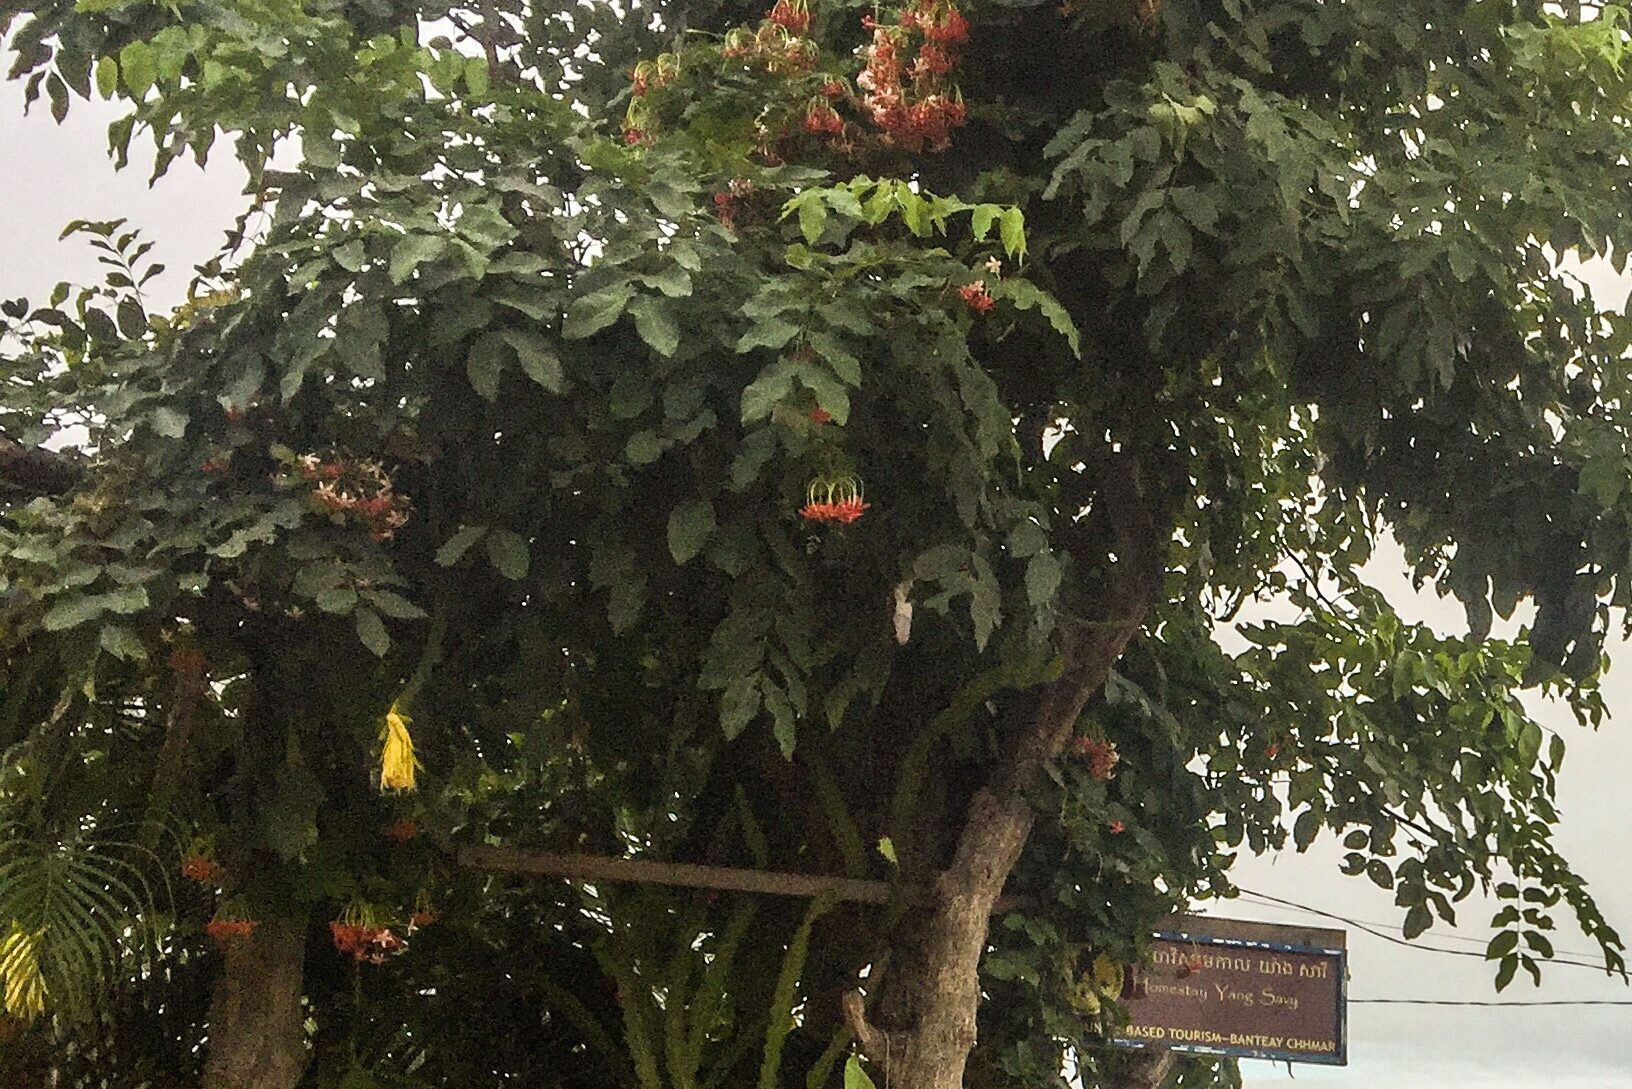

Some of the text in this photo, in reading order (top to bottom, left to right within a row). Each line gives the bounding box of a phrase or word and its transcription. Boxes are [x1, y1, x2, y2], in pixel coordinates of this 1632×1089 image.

[1133, 975, 1208, 1001] Homestay
[1215, 983, 1253, 1007] Yang
[1125, 1024, 1165, 1040] BASED
[1286, 1037, 1336, 1053] CHHMAR
